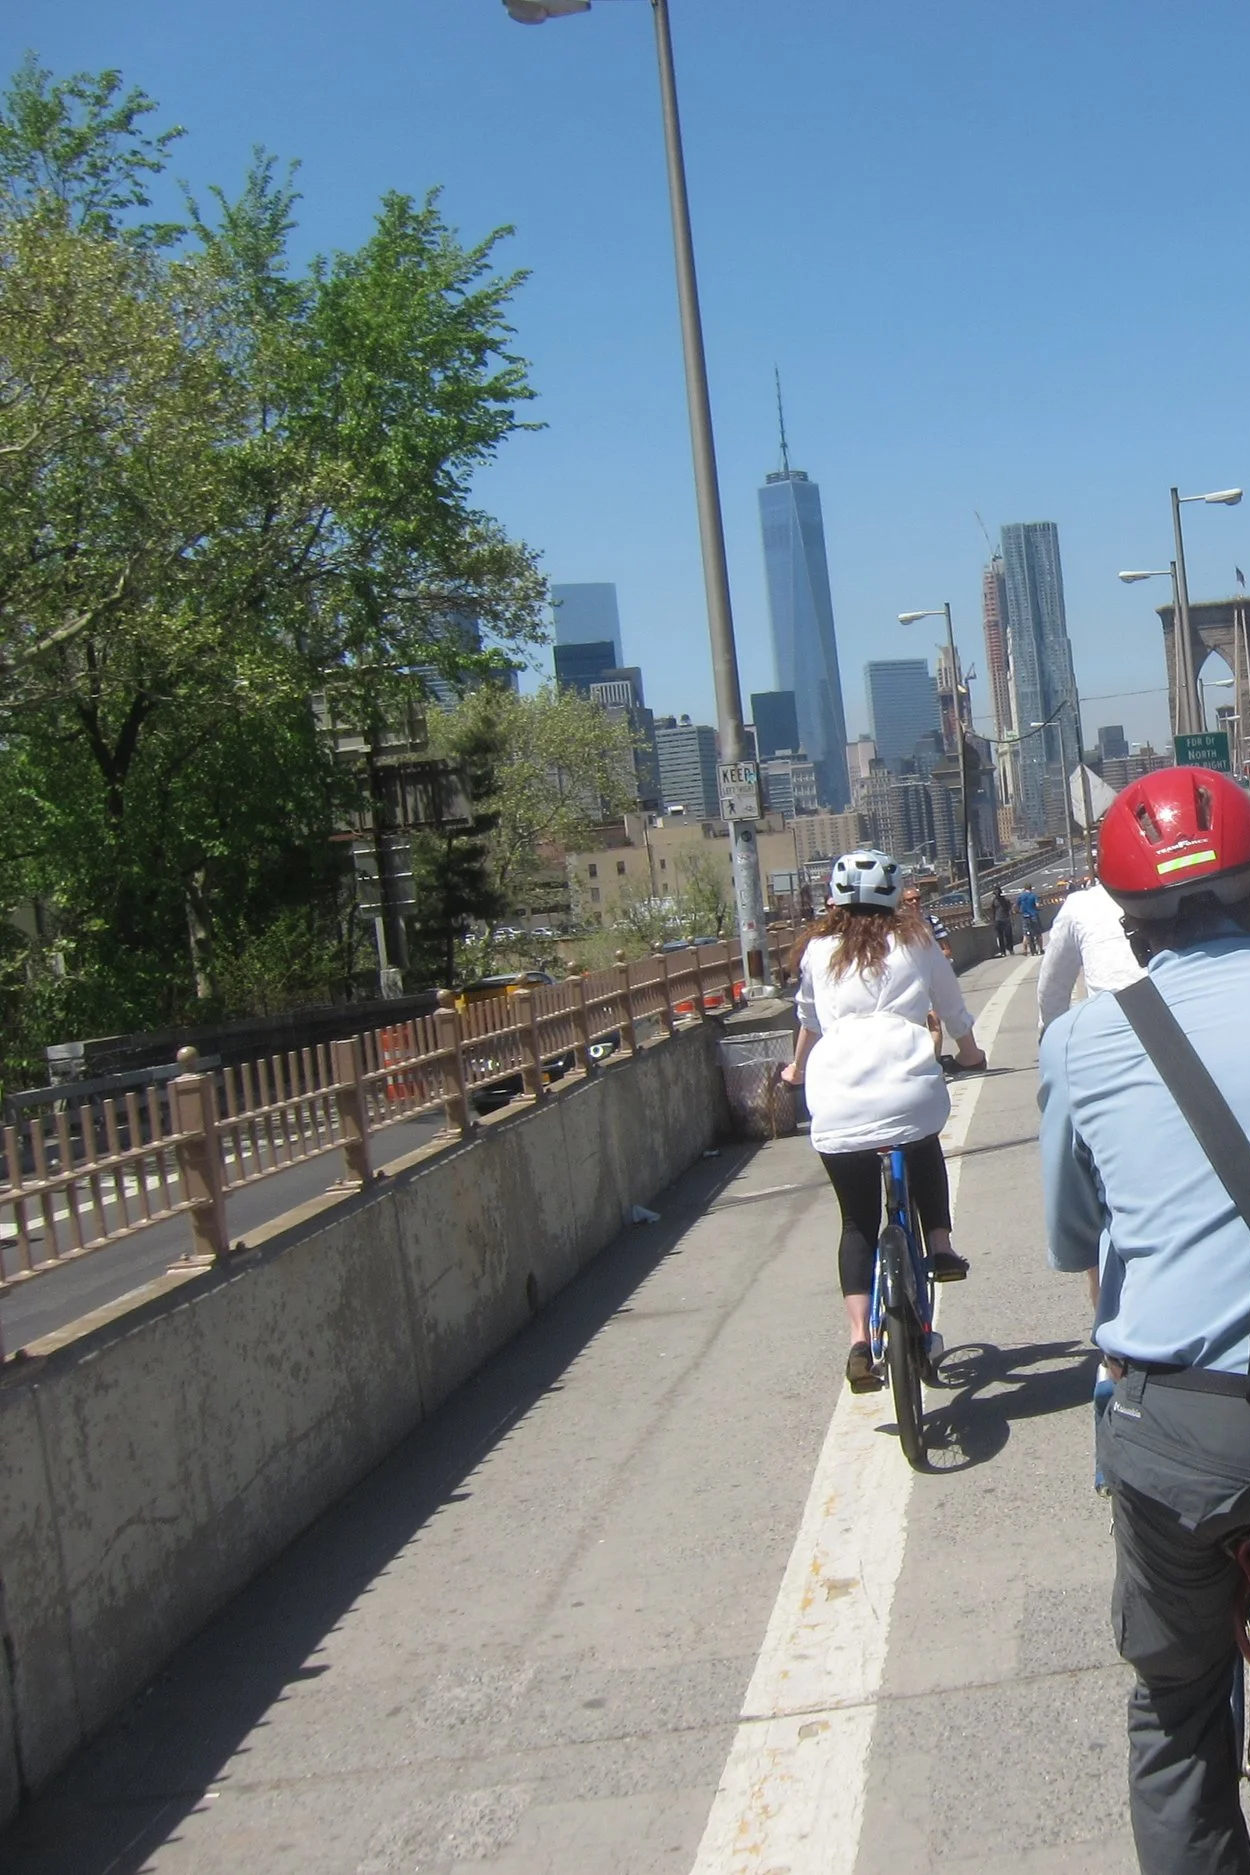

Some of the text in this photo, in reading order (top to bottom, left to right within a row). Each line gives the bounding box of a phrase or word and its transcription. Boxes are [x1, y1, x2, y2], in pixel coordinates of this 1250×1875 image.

[1186, 737, 1203, 748] FDR
[1188, 749, 1217, 760] NORTH
[1203, 760, 1227, 770] RIGHT
[722, 767, 751, 783] KEEP
